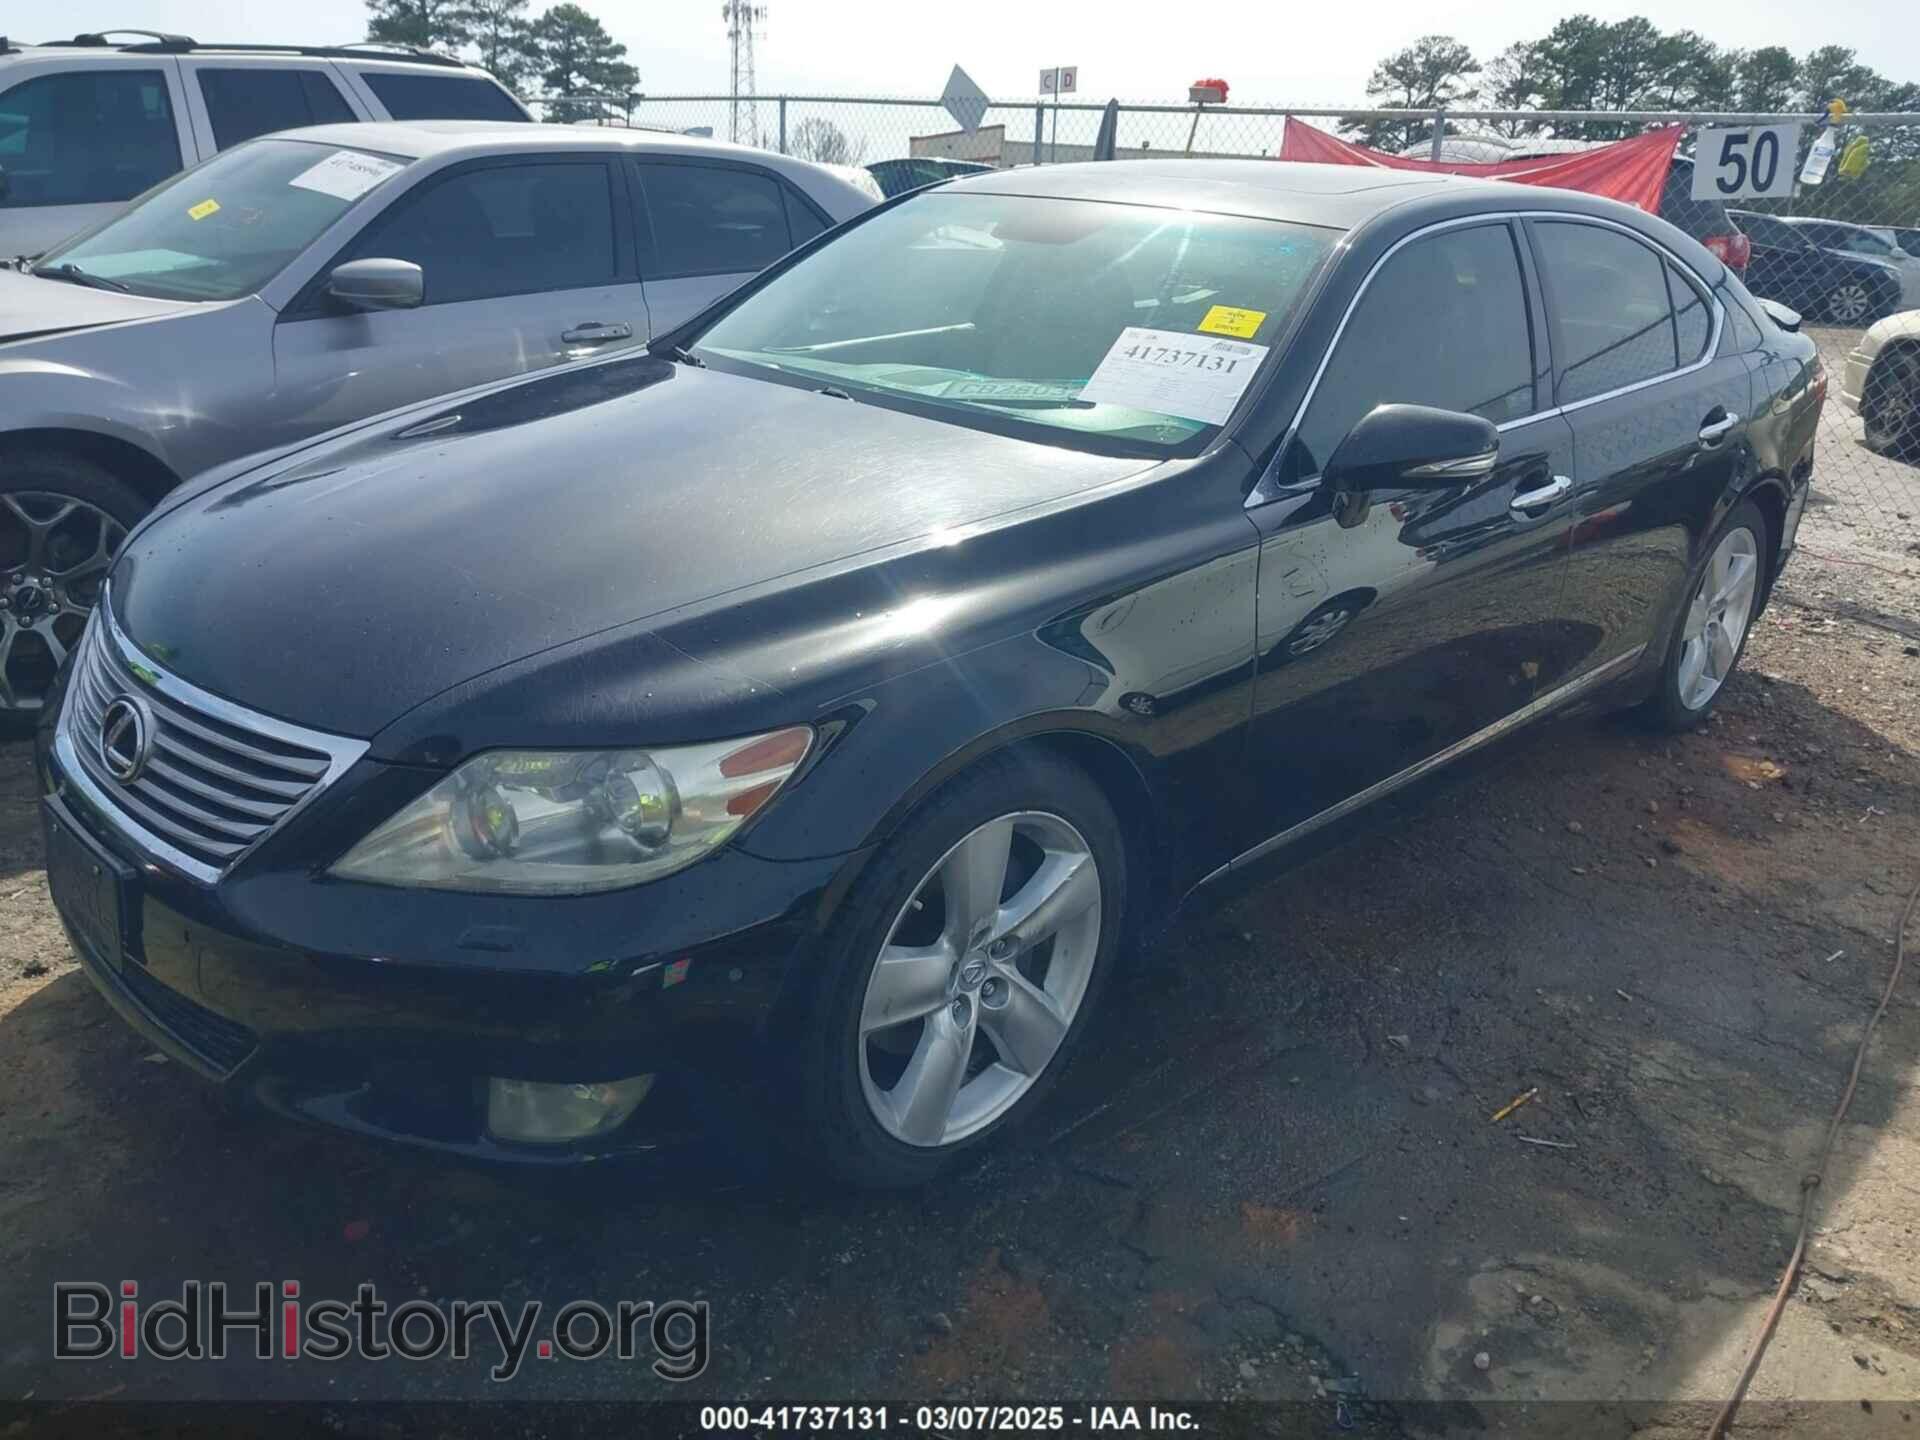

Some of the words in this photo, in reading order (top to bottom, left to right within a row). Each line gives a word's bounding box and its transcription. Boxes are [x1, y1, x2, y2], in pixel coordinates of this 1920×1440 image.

[1063, 72, 1074, 89] D
[1716, 130, 1780, 194] 50
[1124, 344, 1238, 374] 41737131
